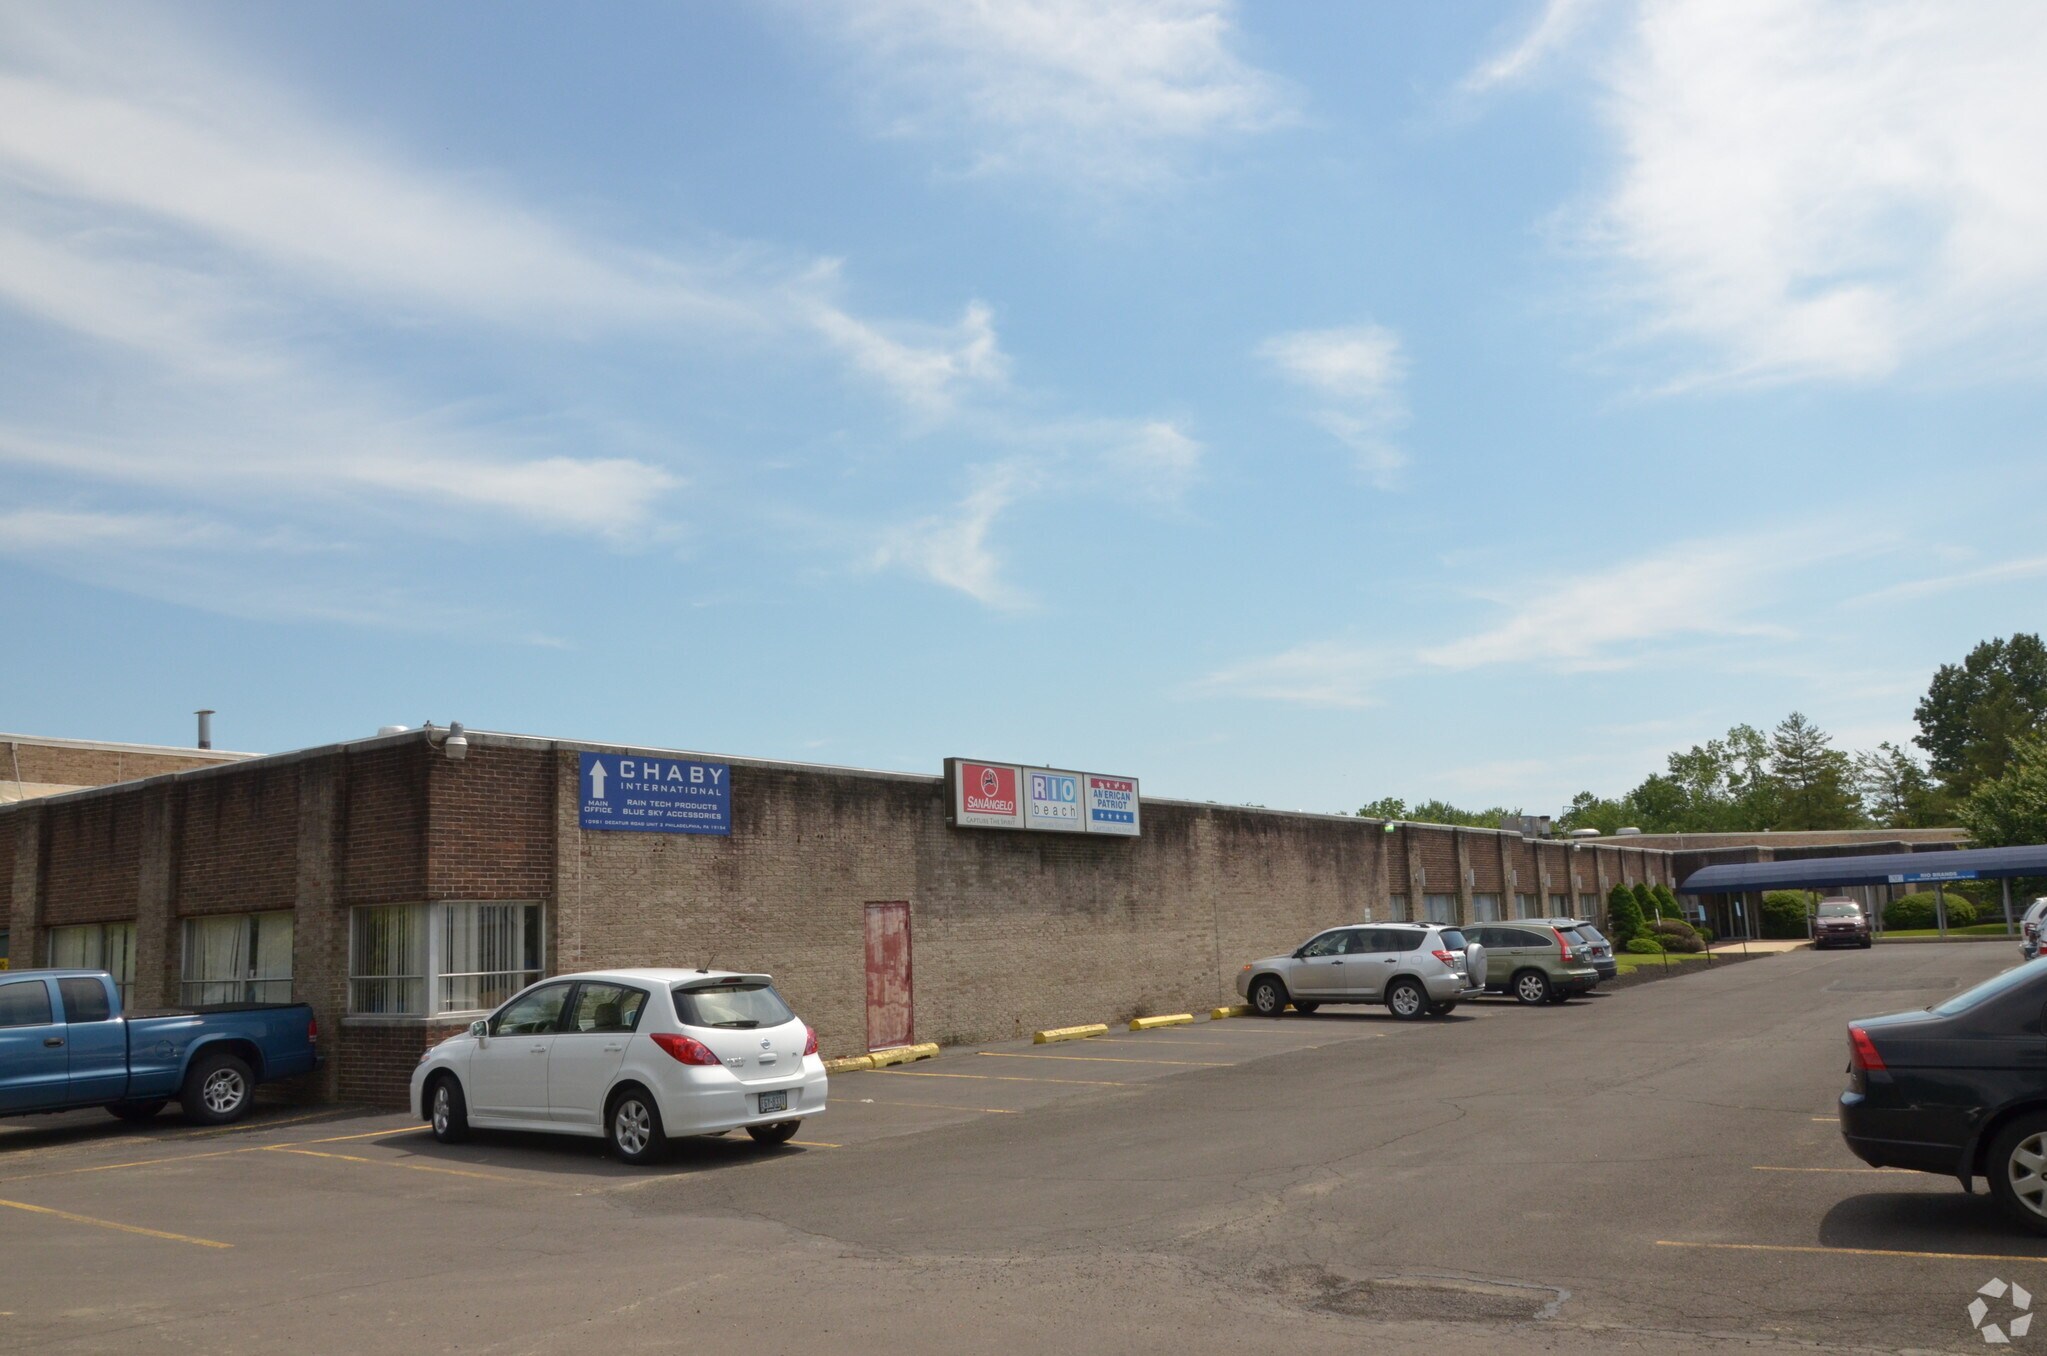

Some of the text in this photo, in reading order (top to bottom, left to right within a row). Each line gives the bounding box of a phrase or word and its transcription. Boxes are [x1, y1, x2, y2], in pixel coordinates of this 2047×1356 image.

[620, 761, 723, 784] CHABY
[621, 782, 722, 796] INTERNATIONAL
[1034, 777, 1074, 800] RIO
[1093, 789, 1131, 801] AMERICAN
[584, 806, 612, 814] OFFICE
[650, 800, 672, 808] TECH
[674, 802, 718, 811] PRODUCTS
[1034, 803, 1076, 817] beach
[1097, 799, 1127, 809] PATRIOT
[647, 809, 664, 817] SKY
[667, 811, 722, 820] ACCESSORIES
